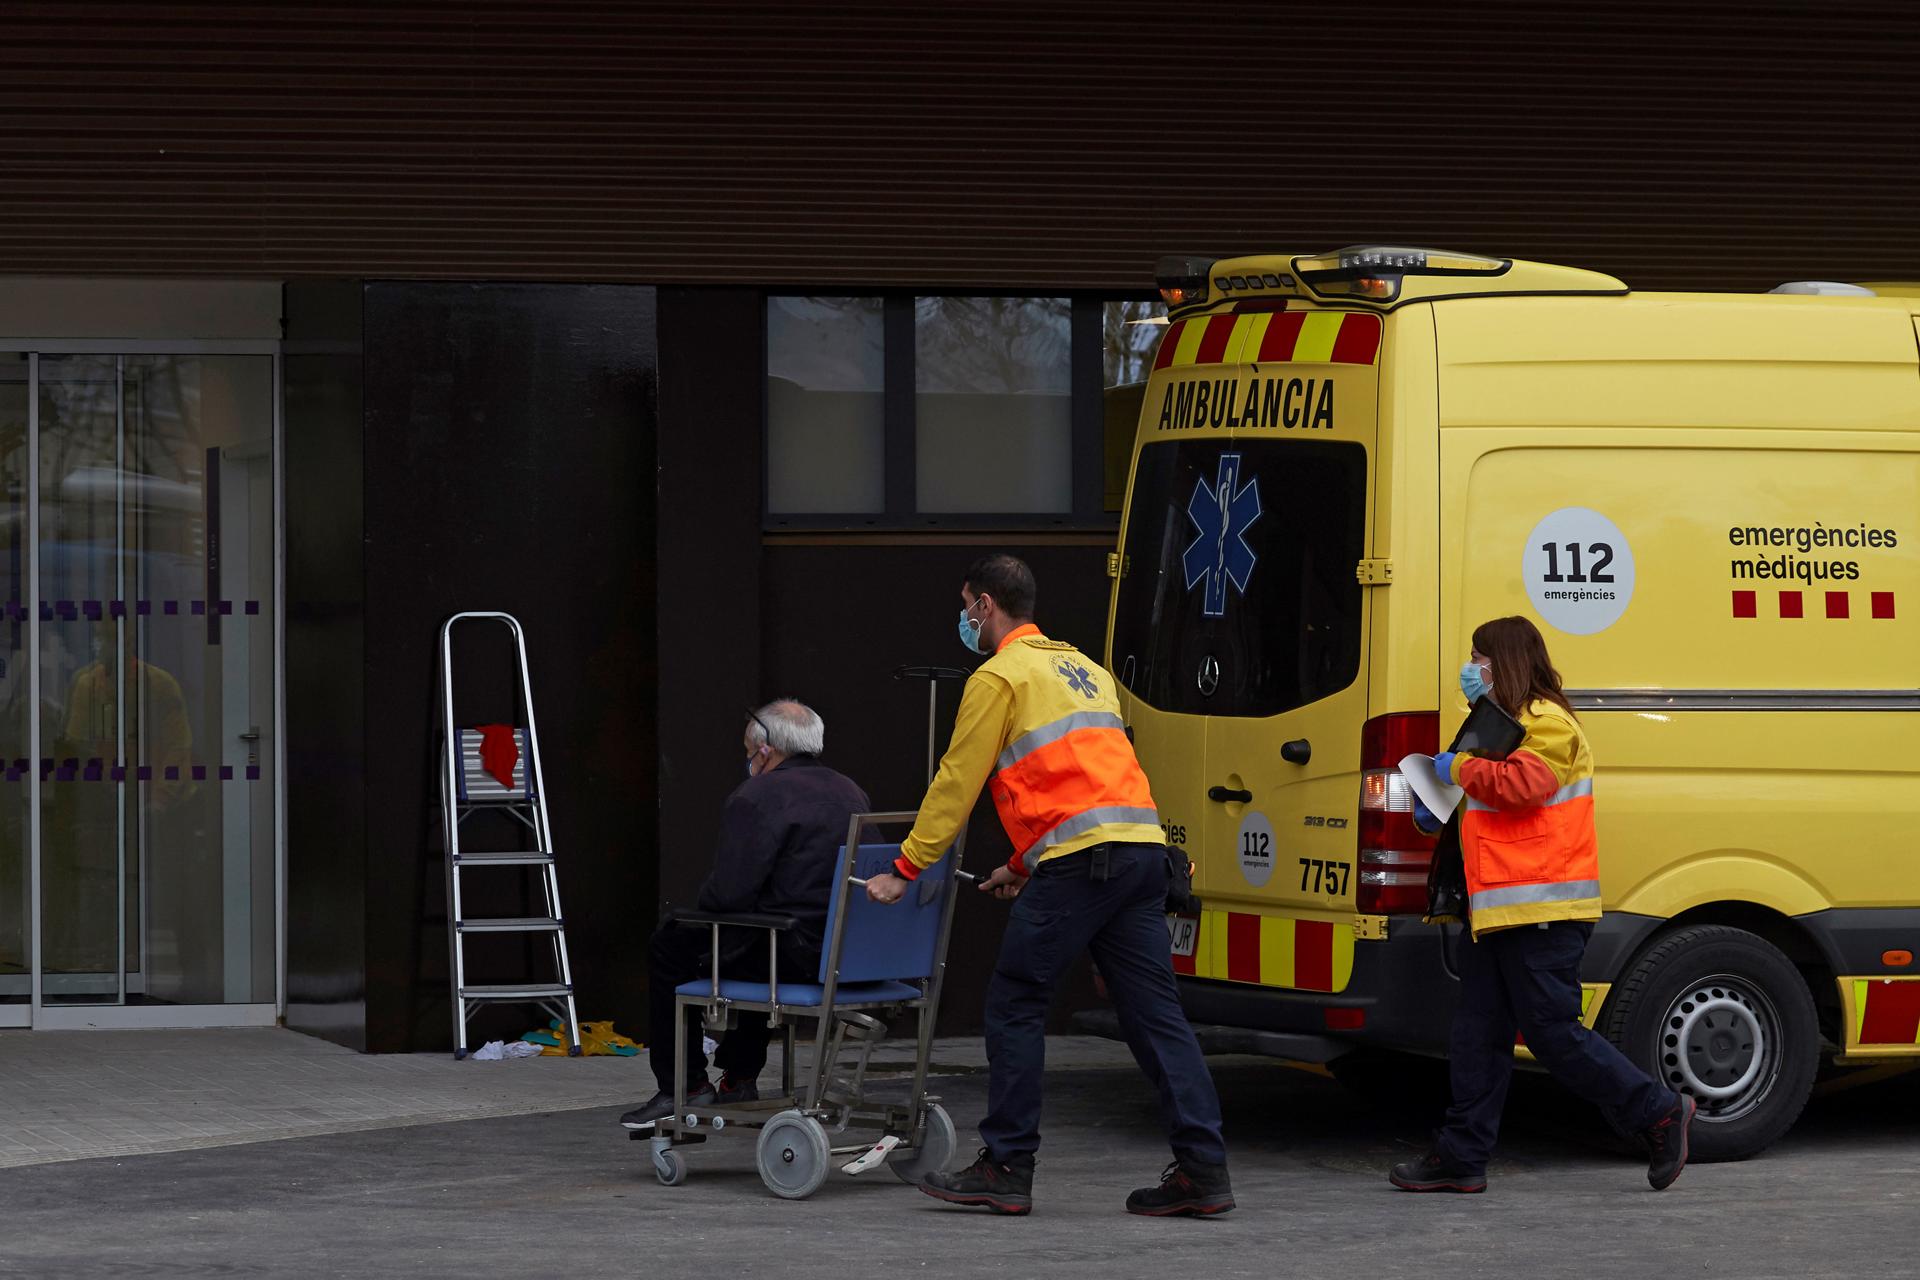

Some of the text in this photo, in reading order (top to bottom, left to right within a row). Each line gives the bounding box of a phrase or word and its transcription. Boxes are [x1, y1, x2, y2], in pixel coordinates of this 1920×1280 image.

[1158, 363, 1334, 430] AMBULÀNCIA
[1728, 522, 1897, 552] emergències
[1541, 542, 1615, 583] 112
[1731, 554, 1860, 585] mèdiques
[1544, 588, 1616, 602] emergències
[1243, 831, 1269, 857] 112
[1299, 858, 1350, 896] 7757
